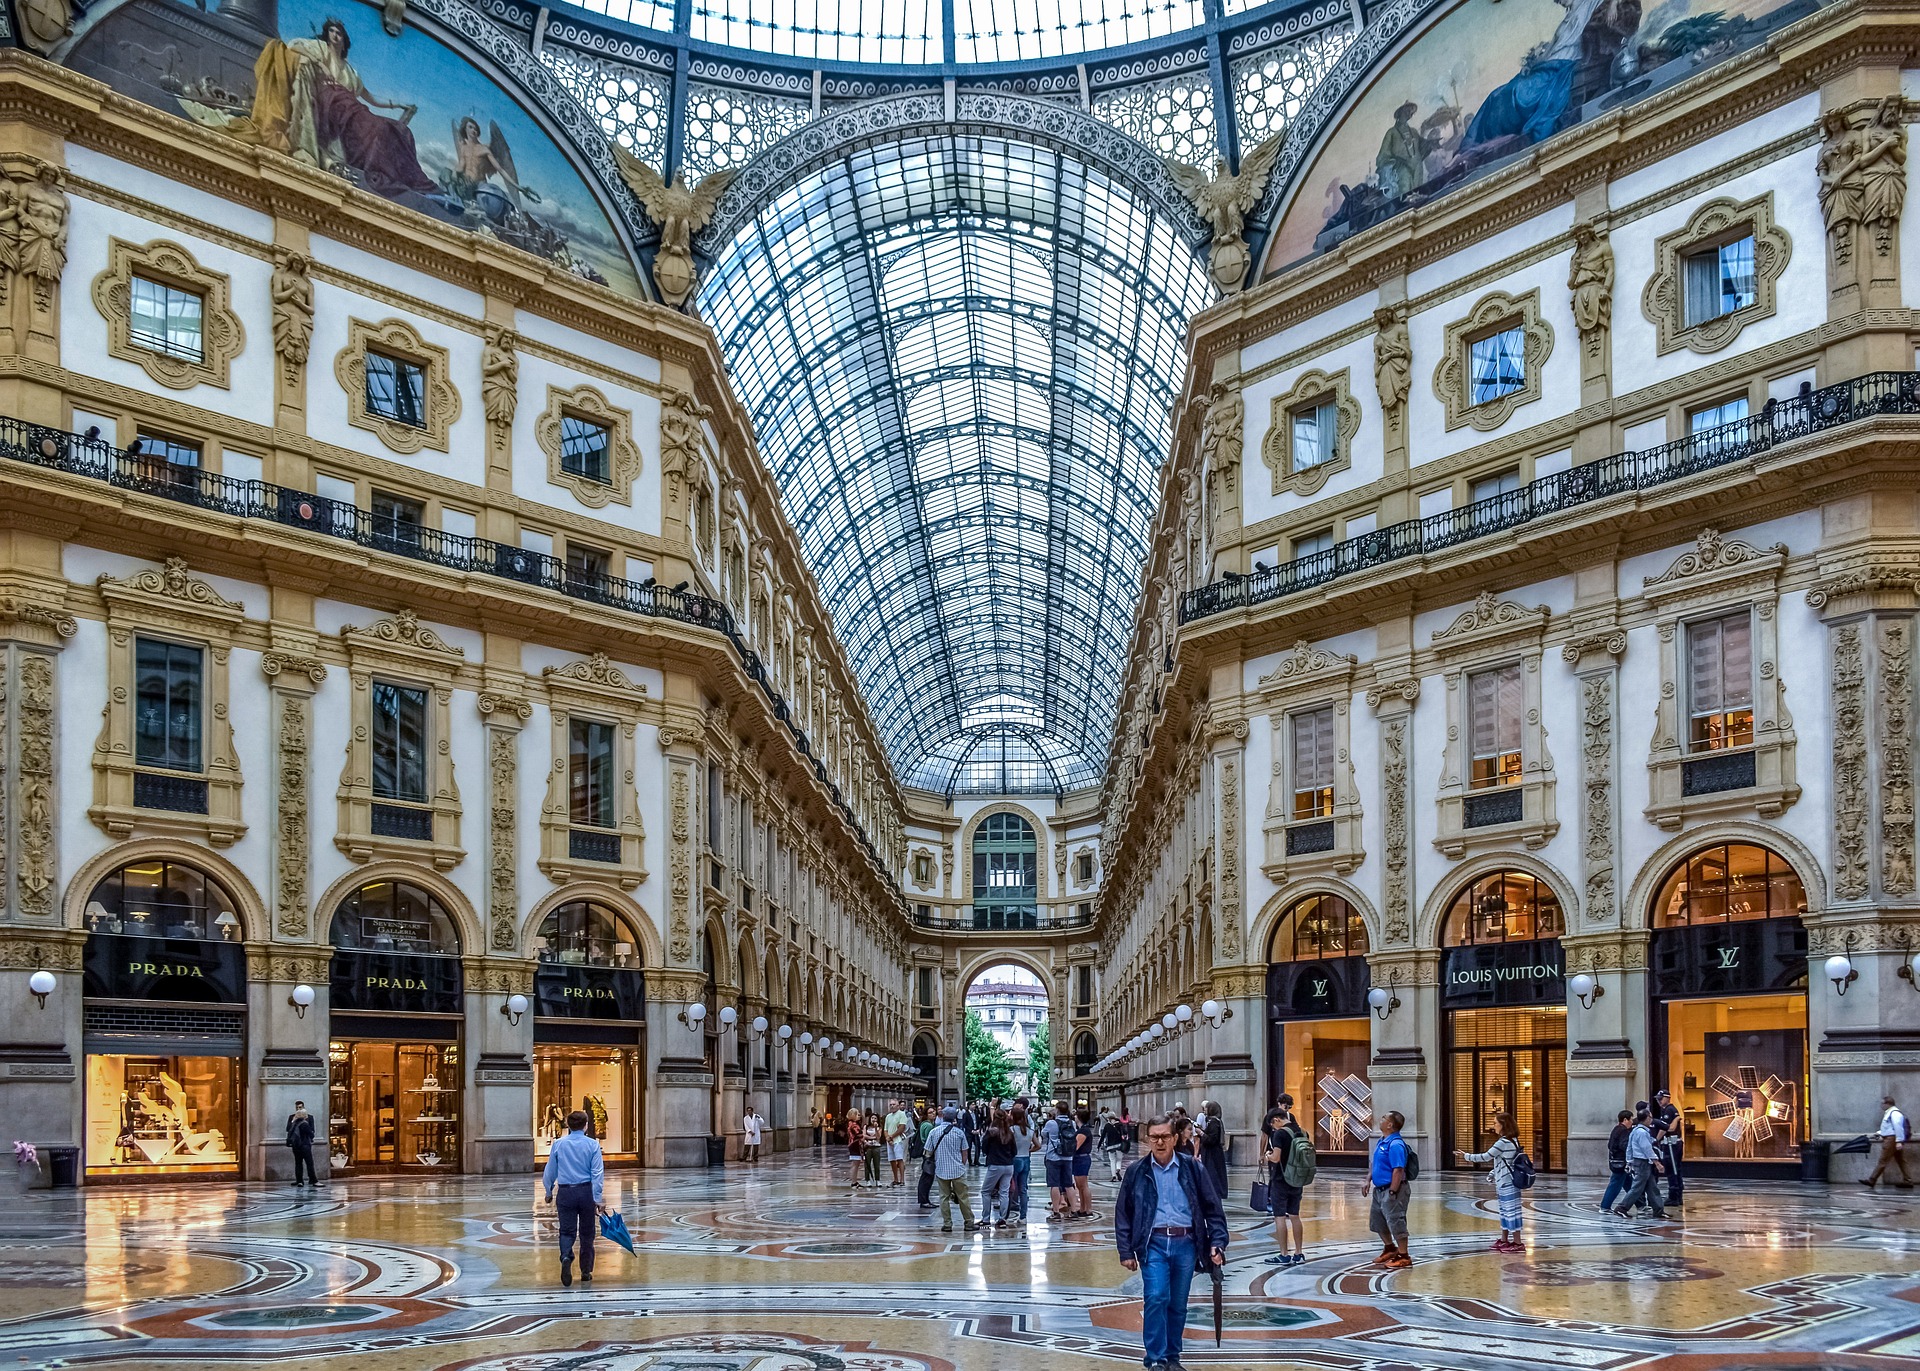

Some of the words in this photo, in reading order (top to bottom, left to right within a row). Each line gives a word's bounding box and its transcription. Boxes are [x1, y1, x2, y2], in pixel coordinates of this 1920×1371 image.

[129, 962, 204, 978] PRADA
[1452, 969, 1492, 984] LOUIS
[1495, 963, 1559, 981] VUITTON
[366, 976, 428, 990] PRADA
[563, 987, 615, 1000] PRADA
